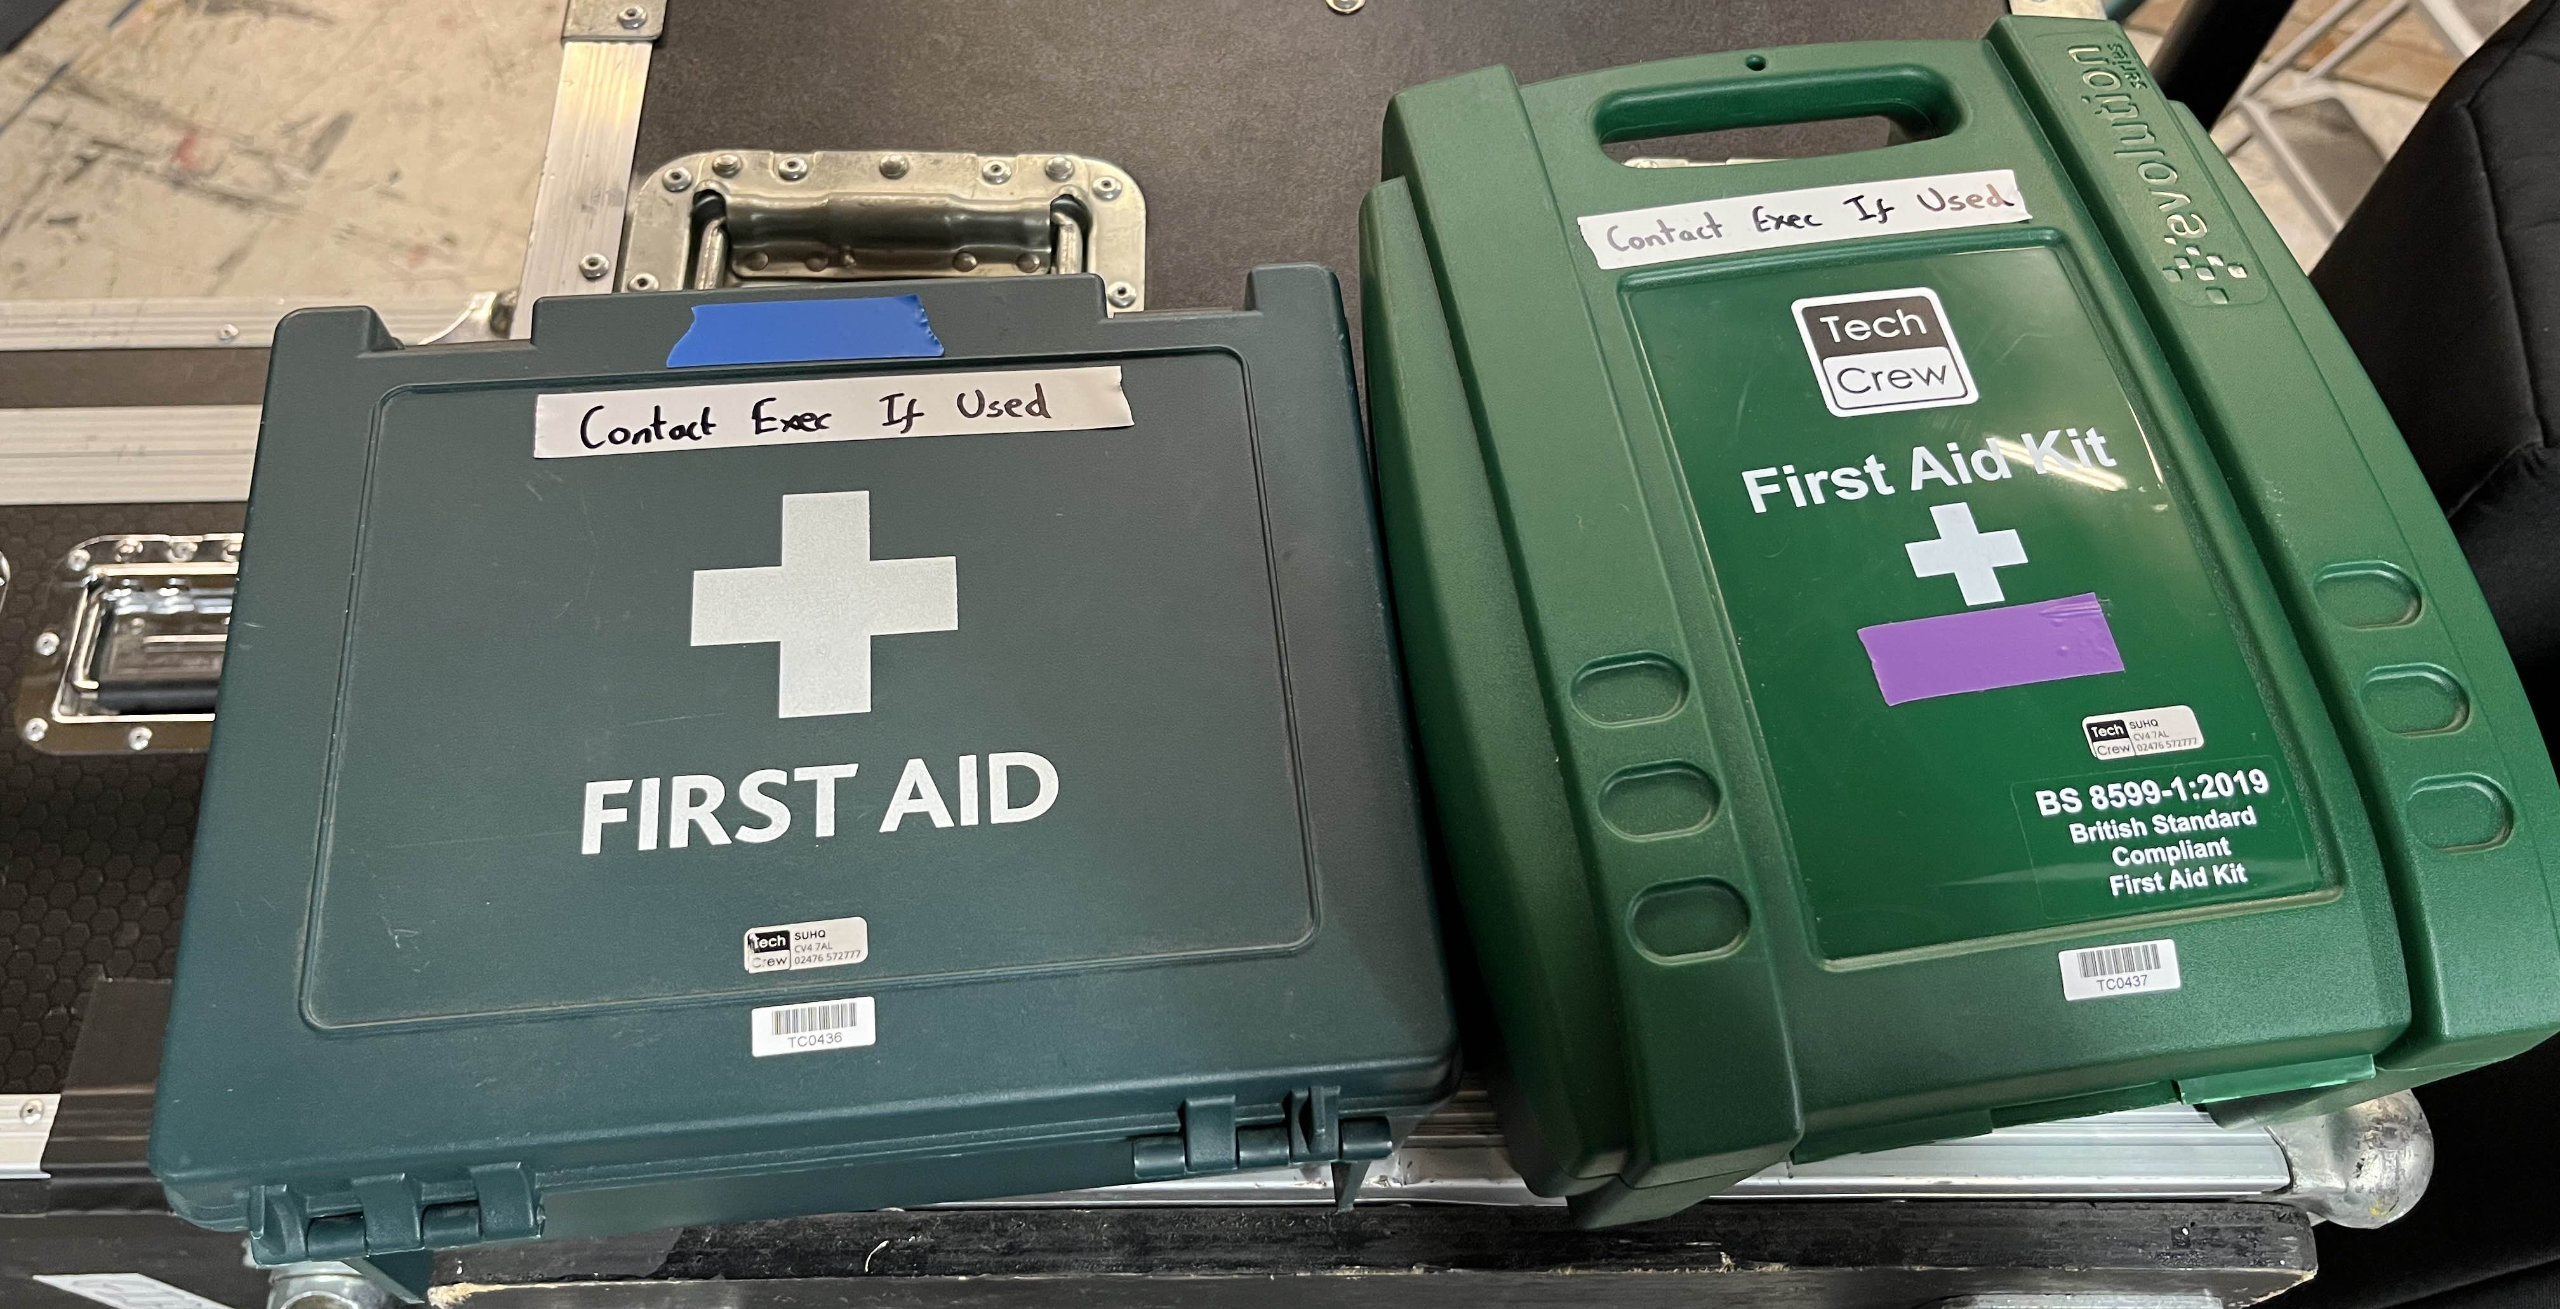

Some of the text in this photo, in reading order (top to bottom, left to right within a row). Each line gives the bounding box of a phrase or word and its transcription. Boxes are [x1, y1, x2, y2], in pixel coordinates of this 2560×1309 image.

[2107, 43, 2147, 90] series
[2068, 44, 2208, 238] evolution
[1607, 184, 2015, 252] Contact Exec If Used
[1820, 309, 1927, 343] Tech
[1837, 362, 1947, 394] Crew
[580, 384, 1052, 449] Contact Exec If Used
[1741, 427, 2117, 514] First Aid Kit
[2091, 724, 2124, 738] Tech
[2129, 719, 2159, 729] SUHQ
[2134, 730, 2169, 741] CV4 7AL
[2097, 743, 2130, 756] Crew
[2136, 738, 2197, 751] 02476 572777
[581, 751, 1059, 854] FIRST AID
[2035, 768, 2269, 814] BS 8599-1:2019
[2069, 806, 2257, 844] British Standard
[2112, 837, 2232, 866] Compliant
[2109, 863, 2249, 896] First Aid Kit
[795, 930, 826, 940] SUHQ
[795, 942, 833, 952] CV4 7AL
[795, 950, 861, 964] 02476 572777
[2096, 975, 2148, 991] TC0437
[788, 1033, 842, 1048] TC0436
